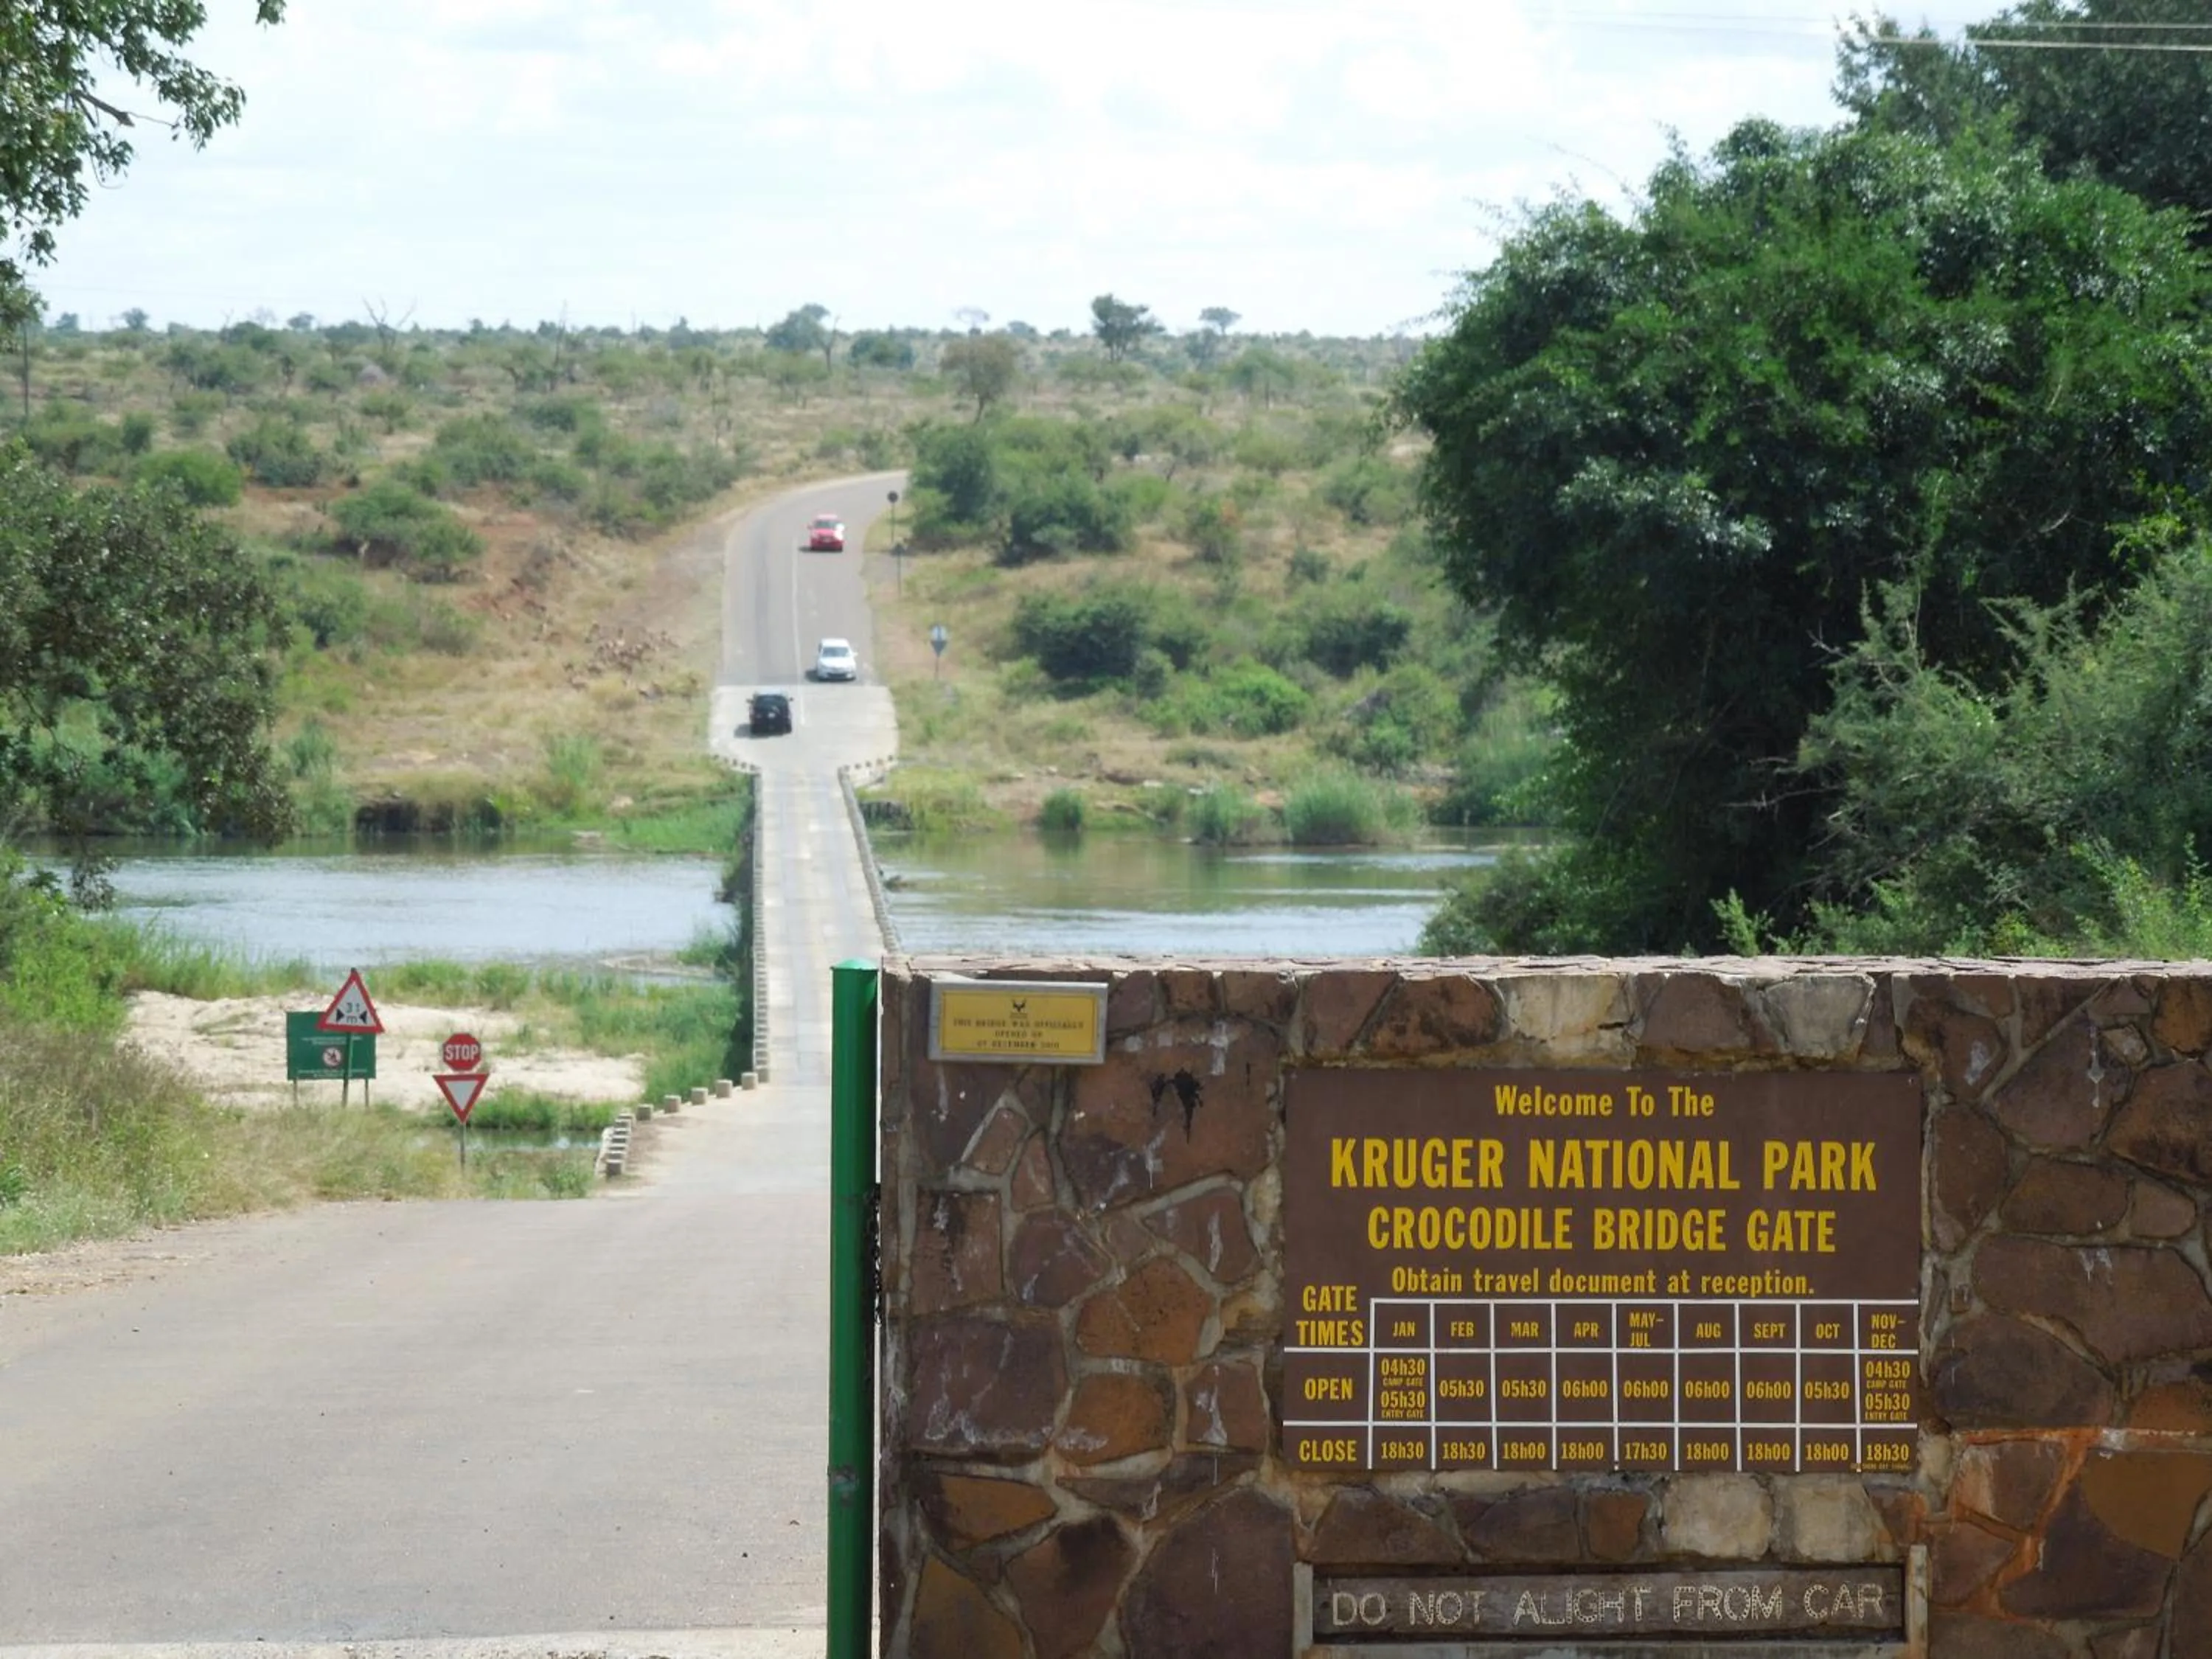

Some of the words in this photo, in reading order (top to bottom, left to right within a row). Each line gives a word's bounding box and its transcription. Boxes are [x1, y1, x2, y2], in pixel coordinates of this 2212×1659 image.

[445, 1044, 479, 1061] STOP
[1495, 1085, 1613, 1117] Welcome
[1627, 1085, 1655, 1117] To
[1669, 1086, 1715, 1118] The
[1330, 1136, 1505, 1191] KRUGER
[1528, 1138, 1742, 1192] NATIONAL
[1761, 1138, 1878, 1192] PARK
[1368, 1205, 1575, 1251] CROCODILE
[1592, 1206, 1727, 1252] BRIDGE
[1746, 1208, 1837, 1253] GATE
[1391, 1266, 1463, 1293] Obtain
[1472, 1267, 1540, 1294] travel
[1548, 1267, 1656, 1295] document
[1667, 1270, 1690, 1295] at
[1700, 1270, 1815, 1298] reception.
[1302, 1284, 1357, 1312] GATE
[1392, 1321, 1416, 1339] JAN
[1450, 1321, 1476, 1339] FEB
[1509, 1321, 1540, 1339] MAR
[1573, 1321, 1599, 1339] APR
[1629, 1312, 1664, 1328] MAY-
[1694, 1321, 1723, 1339] AUG
[1752, 1321, 1786, 1339] SEPT
[1815, 1321, 1841, 1339] OCT
[1871, 1314, 1907, 1329] NOV-
[1295, 1319, 1364, 1346] TIMES
[1630, 1332, 1651, 1347] JUL
[1871, 1333, 1896, 1349] DEC
[1381, 1357, 1425, 1376] 04h30
[1865, 1360, 1910, 1378] 04h30
[1304, 1377, 1353, 1400] OPEN
[1439, 1379, 1485, 1399] 05h30
[1501, 1379, 1548, 1399] 05h30
[1562, 1379, 1607, 1399] 06h00
[1623, 1379, 1669, 1399] 06h00
[1683, 1379, 1730, 1399] 06h00
[1745, 1379, 1792, 1399] 06h00
[1804, 1379, 1851, 1399] 05h30
[1381, 1391, 1425, 1408] 05h30
[1865, 1393, 1910, 1411] 05h30
[1298, 1439, 1357, 1462] CLOSE
[1382, 1441, 1425, 1461] 18h30
[1443, 1441, 1486, 1461] 18h30
[1503, 1441, 1545, 1461] 18h00
[1562, 1441, 1604, 1461] 18h00
[1625, 1441, 1667, 1461] 17h30
[1687, 1441, 1729, 1461] 18h00
[1747, 1441, 1790, 1461] 18h00
[1806, 1441, 1849, 1461] 18h00
[1866, 1441, 1910, 1461] 18h30
[1332, 1592, 1386, 1625] DO
[1409, 1590, 1486, 1625] NOT
[1513, 1586, 1652, 1625] ALIGHT
[1673, 1585, 1783, 1623] FROM
[1804, 1582, 1883, 1619] CAR
